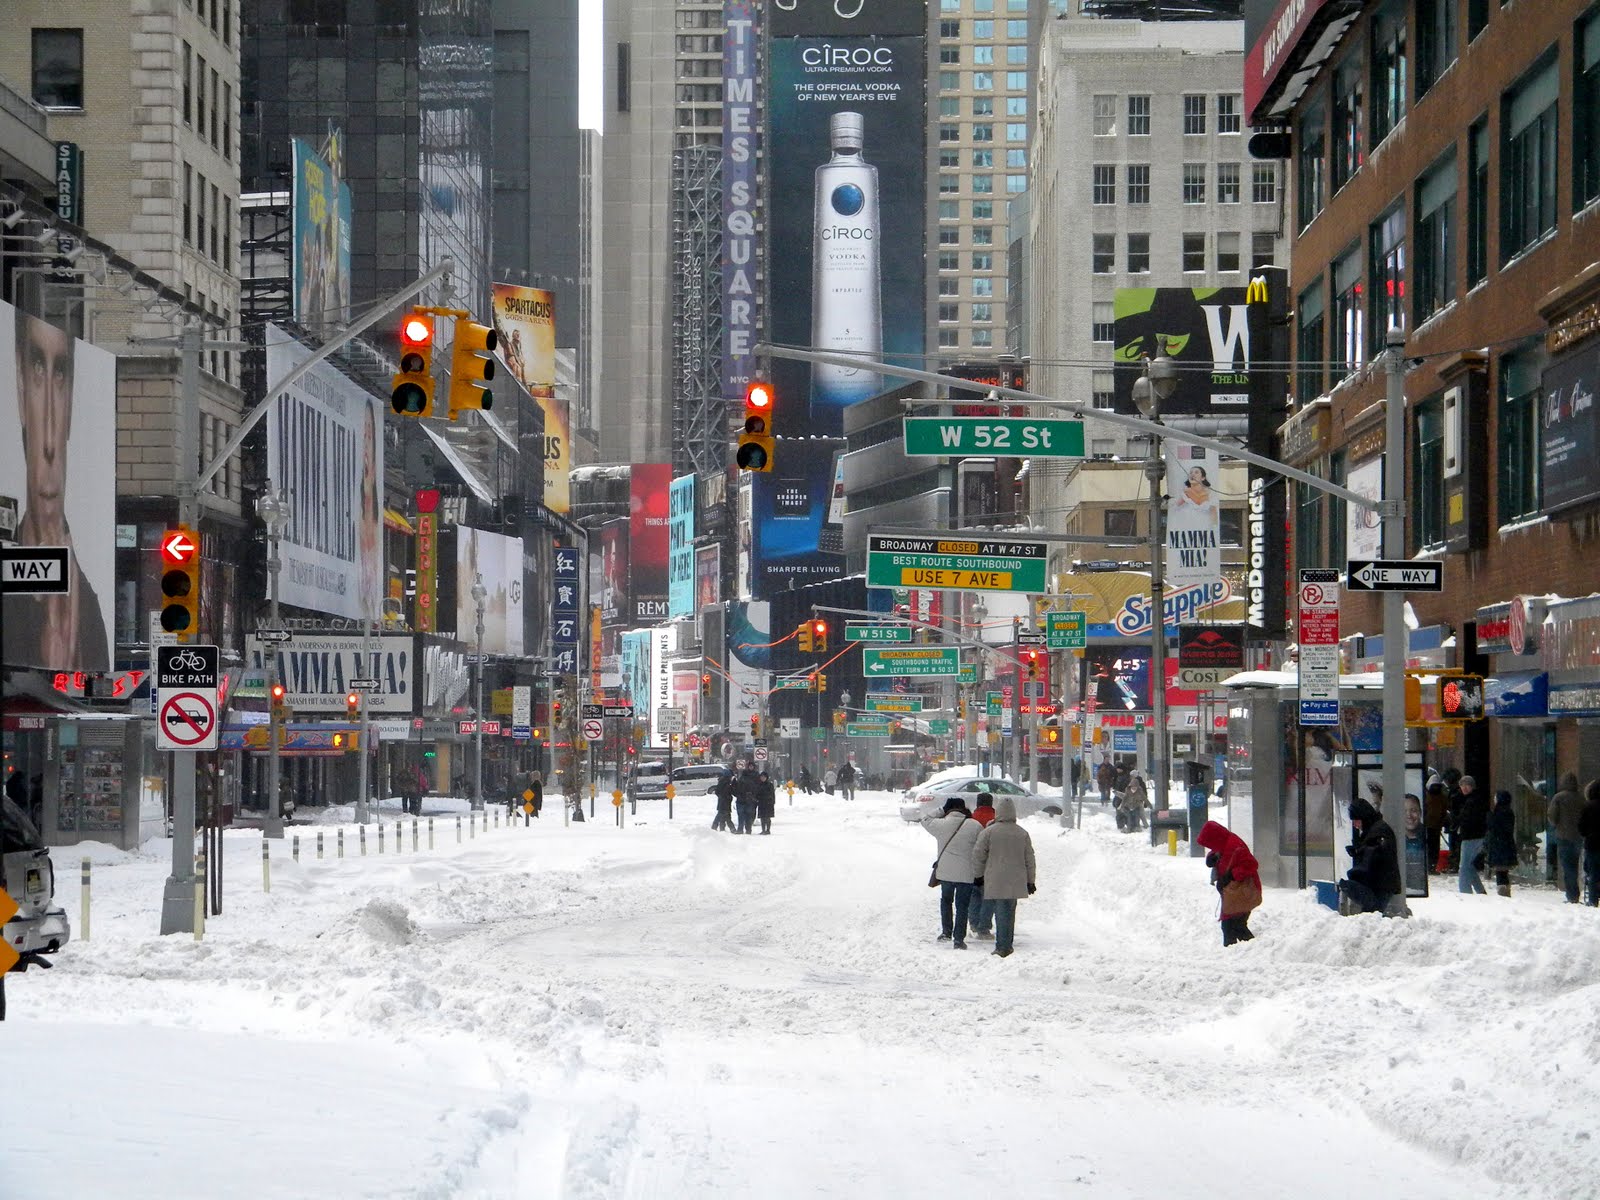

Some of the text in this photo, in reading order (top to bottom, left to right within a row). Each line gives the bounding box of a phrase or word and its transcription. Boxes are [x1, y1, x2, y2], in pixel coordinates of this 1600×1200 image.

[803, 44, 893, 65] CÎROC
[727, 20, 753, 169] TIMES
[794, 83, 901, 91] THE OFFICIAL VODKA
[798, 93, 896, 101] OF NEW YEAR'S EVE
[822, 225, 873, 240] CÎROC
[727, 180, 754, 354] SQUARE
[505, 296, 551, 319] SPARTACUS
[682, 230, 692, 400] AMERICAN EAGLE
[692, 256, 702, 372] OUTFITTERS
[730, 376, 749, 384] NYC
[1211, 374, 1233, 385] THE
[940, 426, 1051, 448] W 52 St
[645, 518, 661, 526] THINGS
[1169, 530, 1216, 549] MAMMA
[880, 540, 1037, 556] BROADWAY CLOSED AT W 47 ST
[893, 556, 1022, 570] BEST ROUTE SOUTHBOUND
[1180, 549, 1208, 568] MIA!
[11, 562, 53, 579] WAY
[1362, 570, 1430, 582] ONE WAY
[914, 570, 999, 587] USE 7 AVE
[860, 630, 898, 638] W 51 St
[162, 674, 213, 684] BIKE PATH
[1182, 669, 1218, 683] Così
[660, 685, 669, 700] EAGLE
